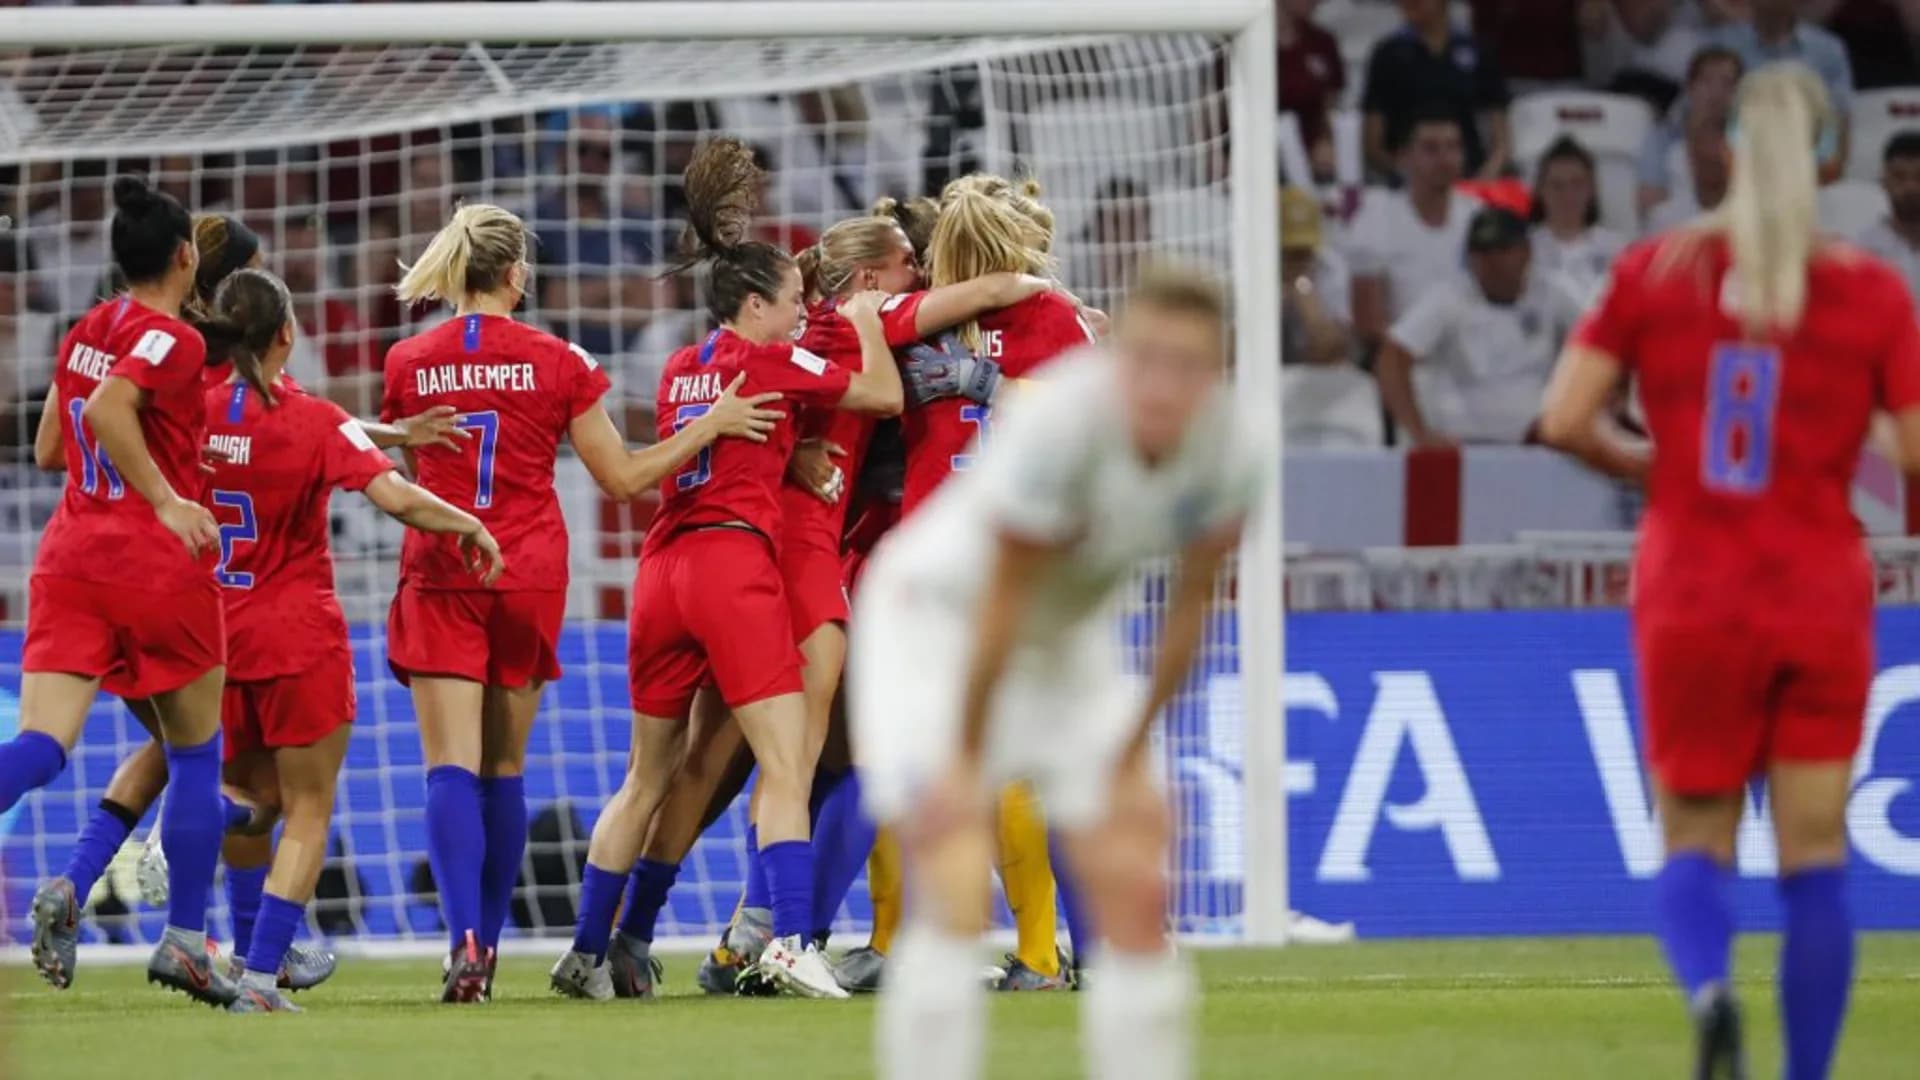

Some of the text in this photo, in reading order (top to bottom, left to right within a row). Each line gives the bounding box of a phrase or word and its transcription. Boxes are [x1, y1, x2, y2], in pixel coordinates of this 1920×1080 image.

[416, 363, 536, 396] DAHLKEMPER
[668, 371, 724, 403] O'HARA
[208, 434, 252, 465] PUGH
[1699, 342, 1785, 496] 8
[453, 410, 499, 508] 7
[212, 488, 258, 590] 2
